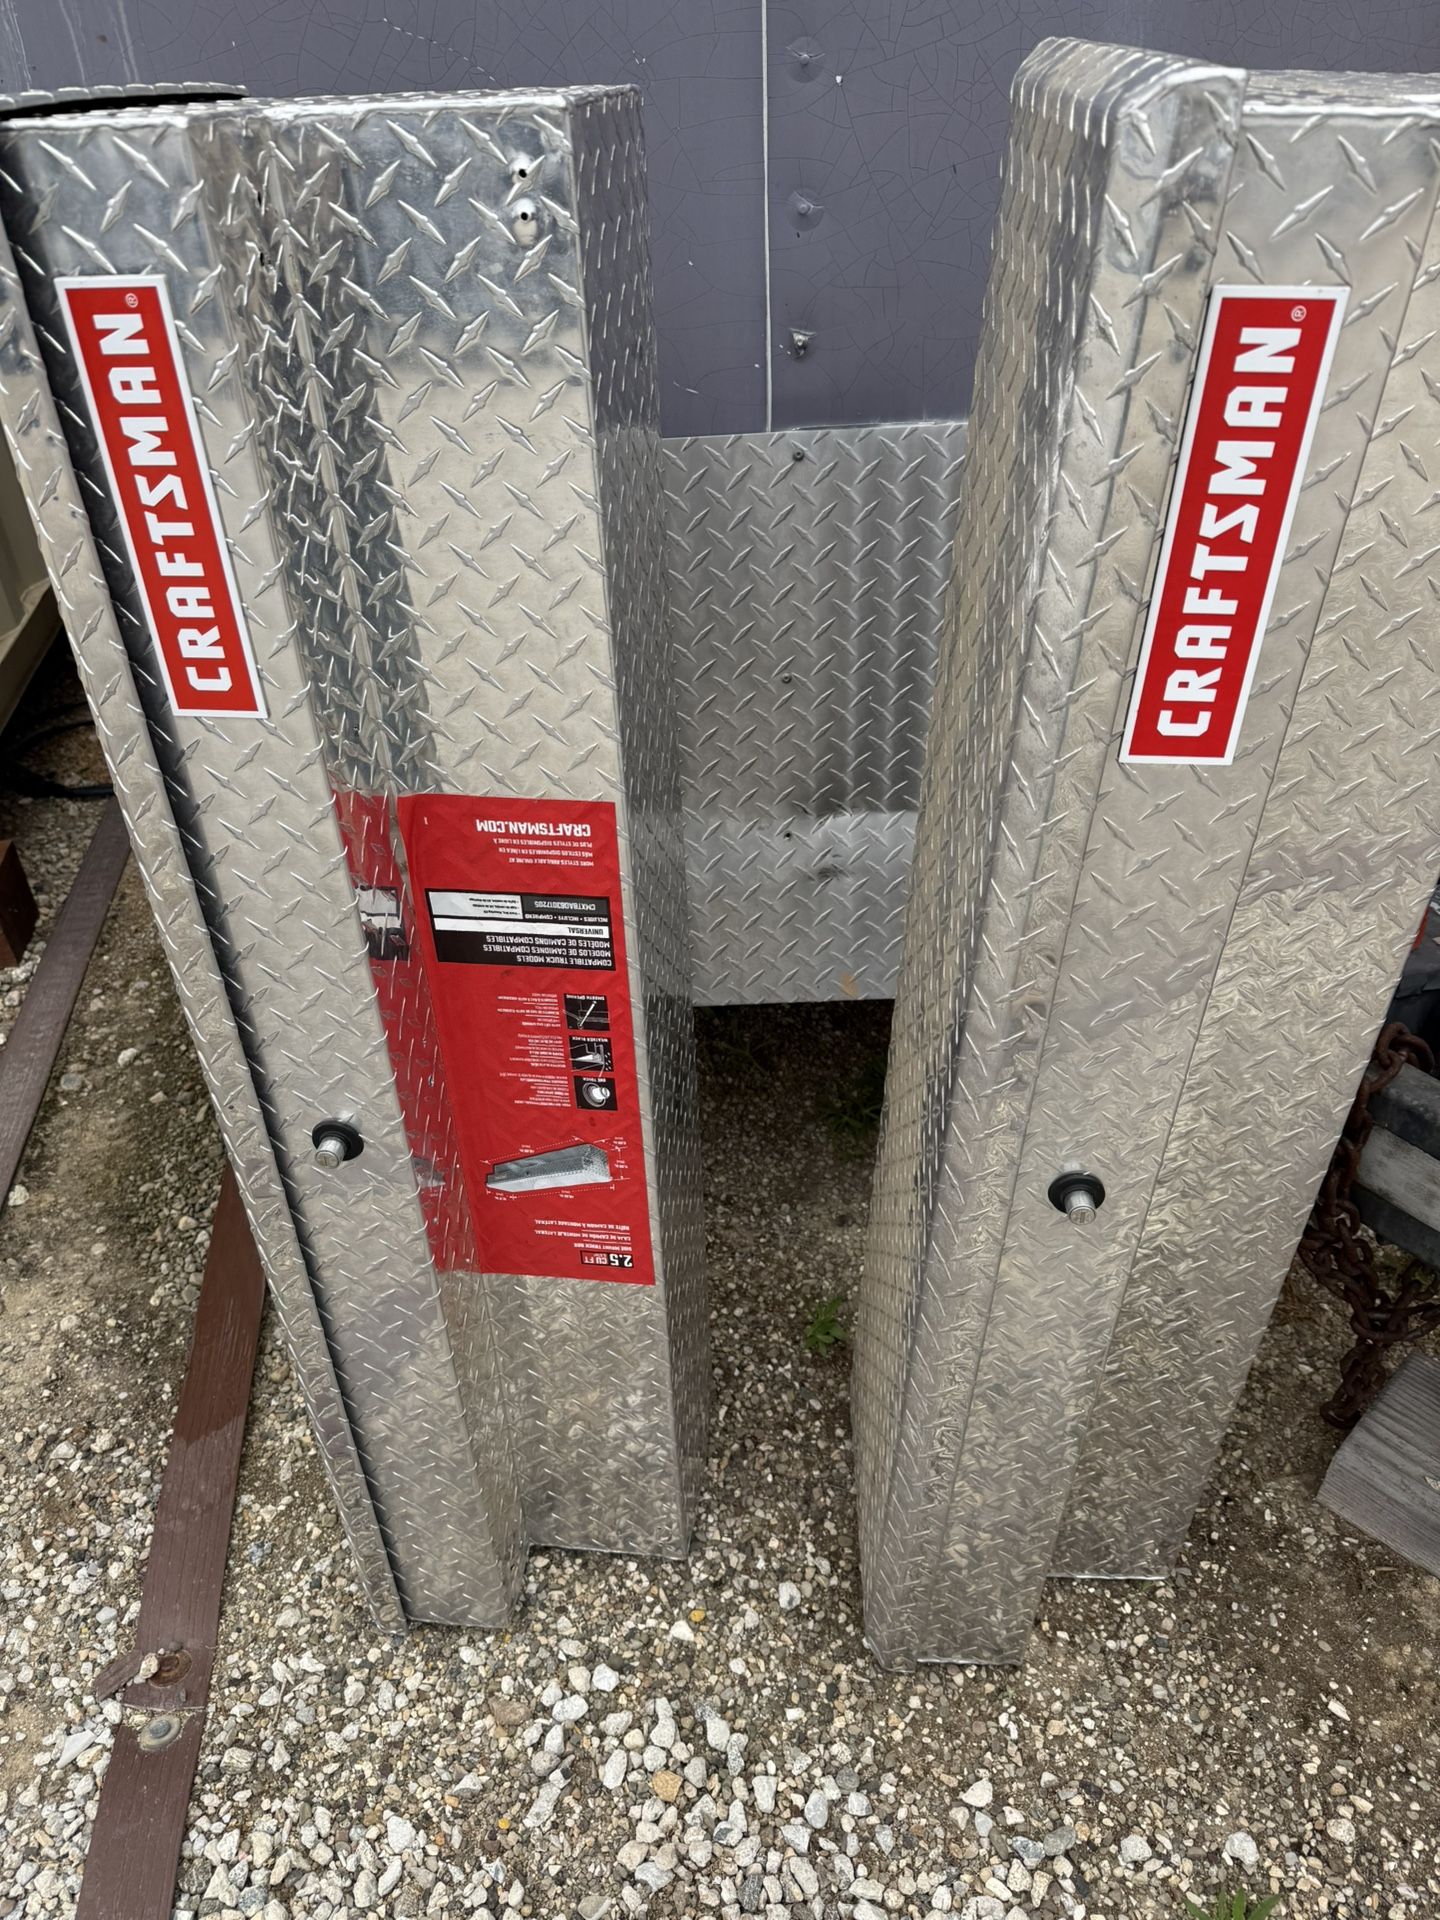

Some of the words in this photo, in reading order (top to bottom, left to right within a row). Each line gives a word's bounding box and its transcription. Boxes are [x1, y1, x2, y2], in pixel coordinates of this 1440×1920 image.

[476, 819, 591, 837] CRAFTSMAN.COM
[568, 927, 603, 935] UNIVERSAL
[486, 935, 533, 944] COMPATIBLES
[535, 938, 566, 946] CAMIONS
[578, 940, 610, 948] MODÈLES
[483, 945, 530, 953] COMPATIBLES
[570, 958, 612, 966] COMPATIBLE
[610, 1254, 633, 1267] 2.5
